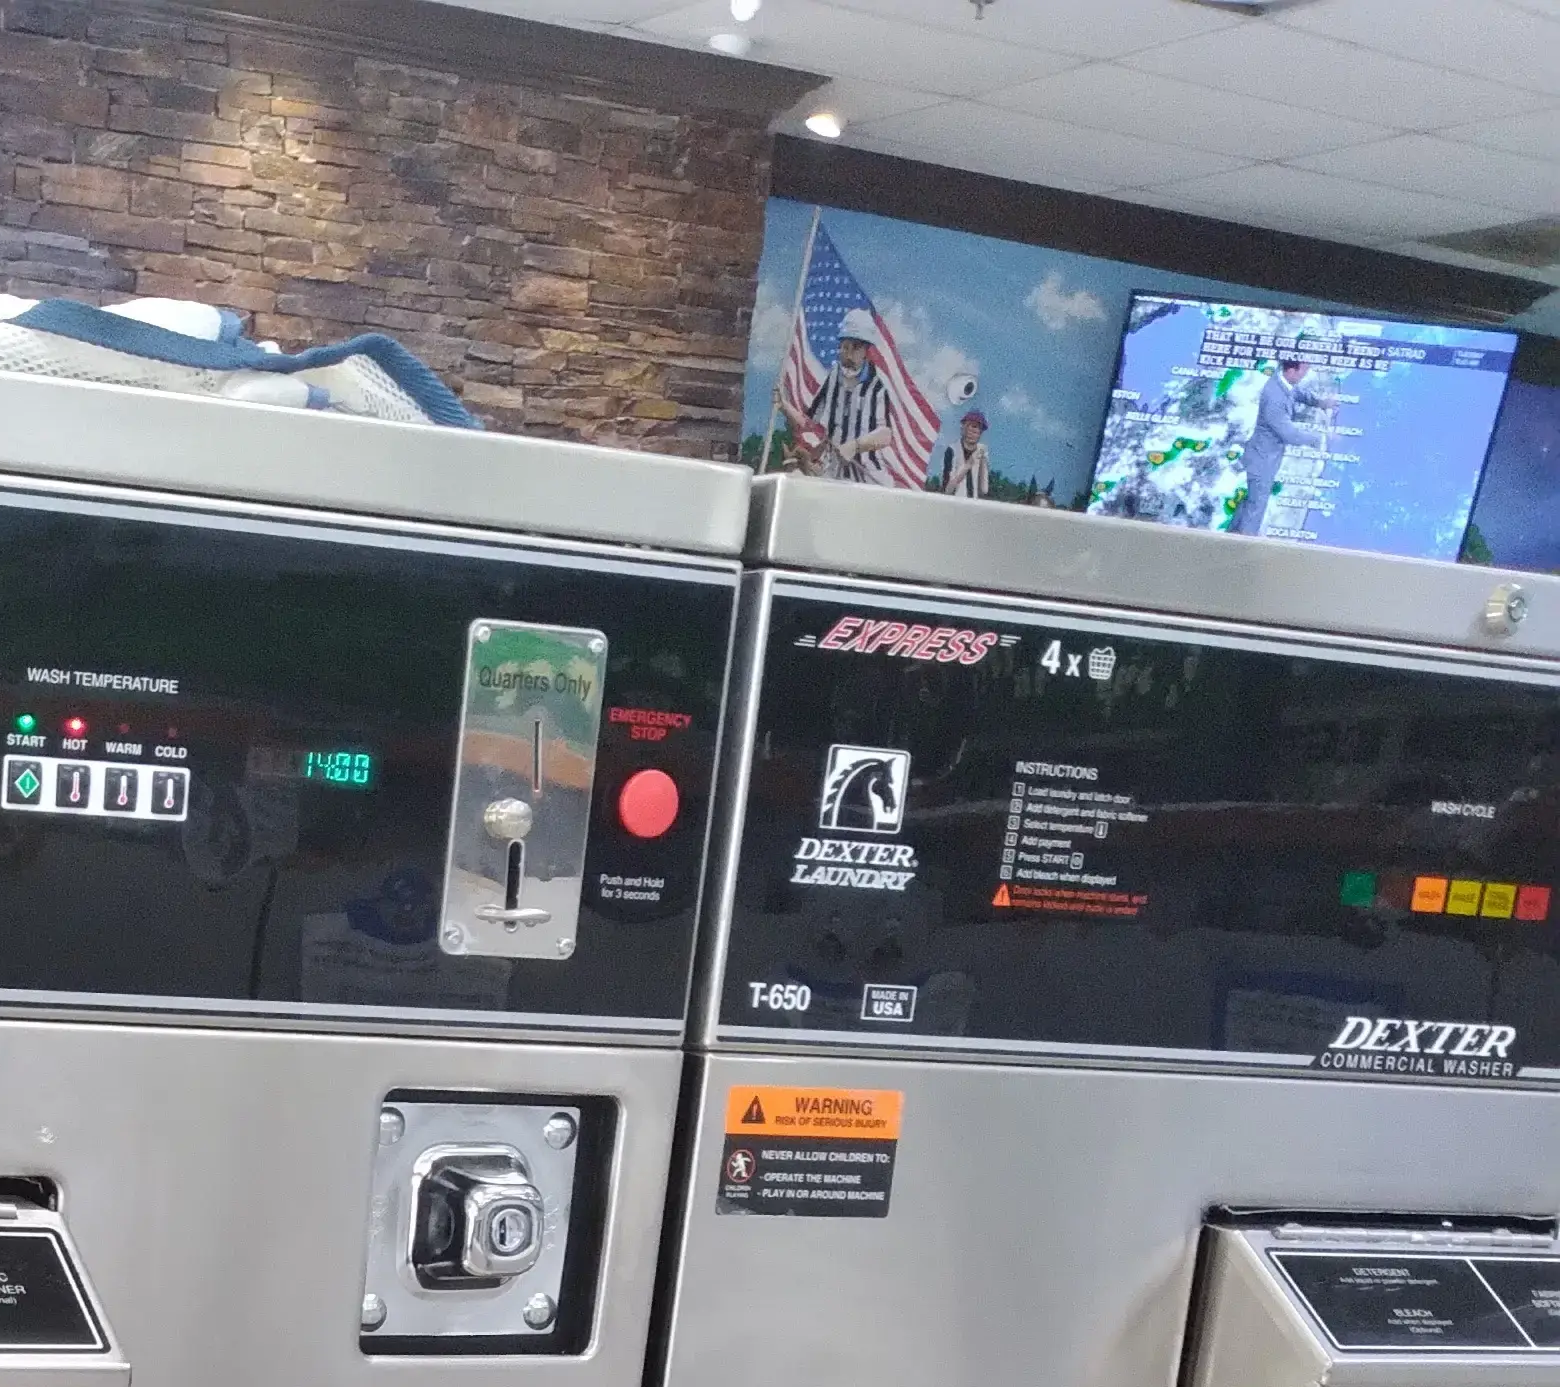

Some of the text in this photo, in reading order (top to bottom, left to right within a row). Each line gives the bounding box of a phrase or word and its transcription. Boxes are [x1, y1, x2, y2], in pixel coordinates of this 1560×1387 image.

[1297, 339, 1345, 353] GENERAL
[818, 616, 998, 665] EXPRESS
[1040, 640, 1061, 674] 4
[27, 668, 179, 694] WASH TEMPERATURE
[478, 666, 592, 699] Quarters Only
[609, 707, 692, 728] EMERGENCY
[7, 734, 46, 747] START
[631, 726, 666, 741] STOP
[63, 738, 88, 751] HOT
[106, 742, 142, 756] WARM
[155, 746, 187, 759] COLD
[1016, 760, 1098, 781] INSTRUCTIONS
[1431, 800, 1496, 818] WASH CYCLE
[600, 874, 664, 888] Push and Hold
[790, 863, 915, 891] LAUNDRY
[601, 888, 660, 900] for 3 seconds
[749, 982, 812, 1011] T-650
[871, 988, 908, 1001] MADE IN
[872, 1001, 904, 1017] USA
[1329, 1016, 1516, 1057] DEXTER
[1321, 1052, 1513, 1077] COMMERCIAL WASHER
[796, 1097, 872, 1115] WARNING
[761, 1150, 793, 1160] NEVER
[795, 1151, 827, 1161] ALLOW
[829, 1153, 874, 1162] CHILDREN
